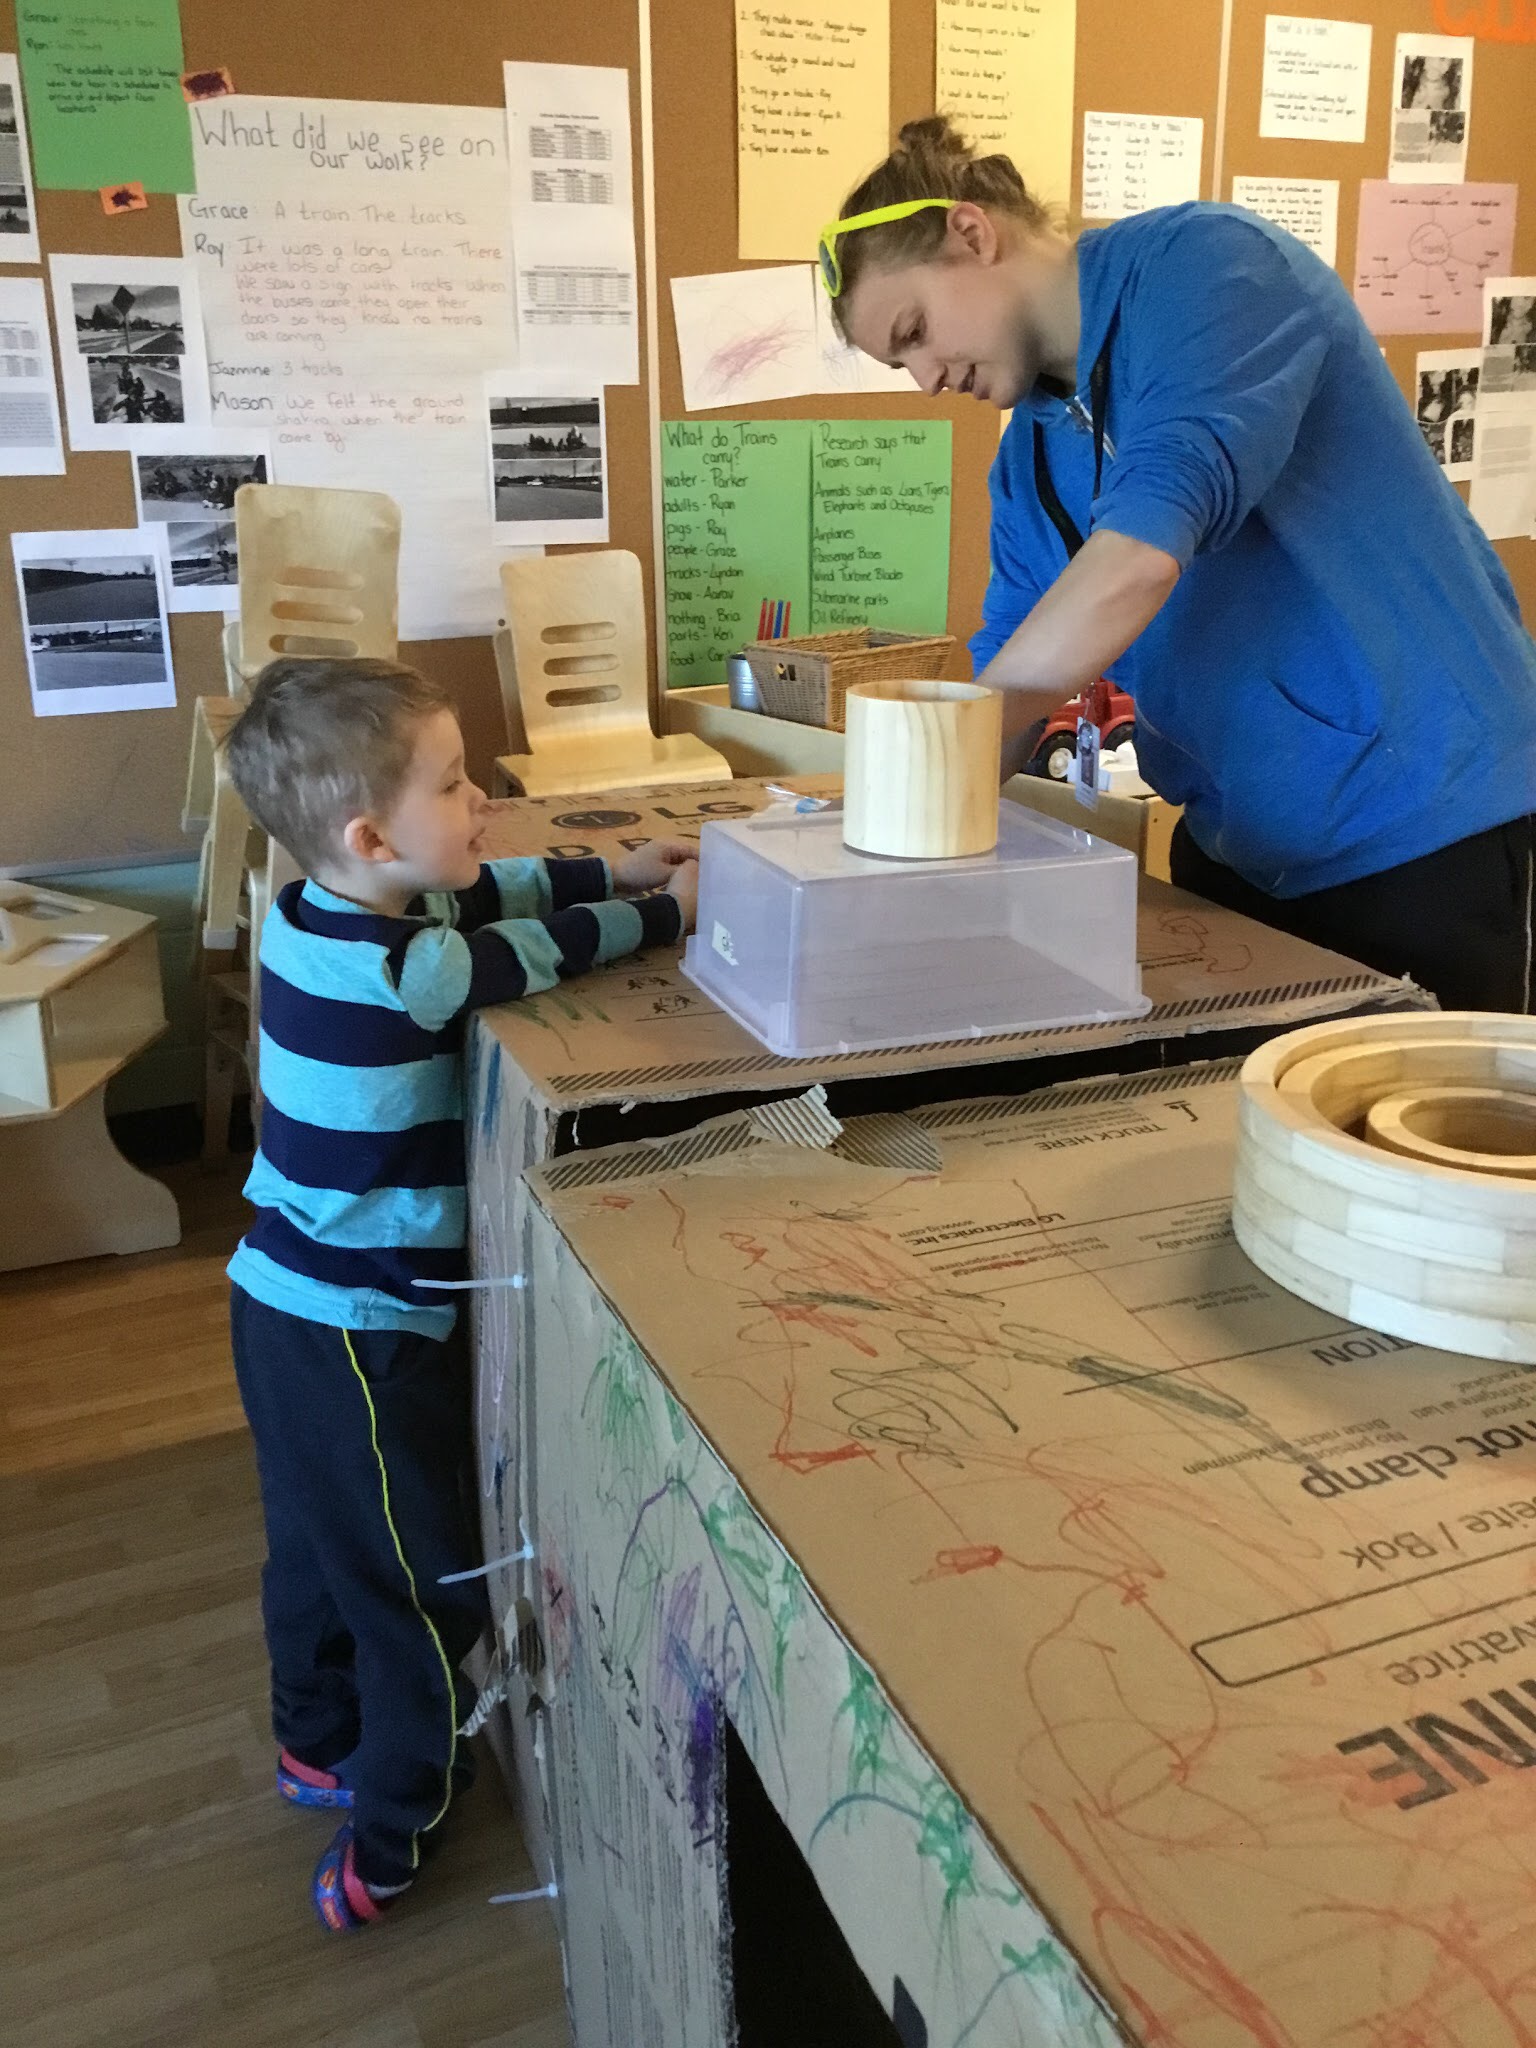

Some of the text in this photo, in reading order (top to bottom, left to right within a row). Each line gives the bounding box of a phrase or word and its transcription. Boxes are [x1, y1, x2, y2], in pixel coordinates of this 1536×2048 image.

[195, 107, 495, 156] What did we see on
[275, 200, 286, 220] A
[359, 204, 396, 223] The
[409, 203, 467, 225] tracks
[238, 236, 267, 255] It
[282, 242, 324, 257] was
[334, 244, 343, 259] a
[354, 240, 392, 262] long
[453, 241, 504, 260] There
[237, 260, 278, 274] were
[287, 259, 318, 274] lots
[327, 259, 343, 274] of
[266, 278, 296, 291] saw
[303, 279, 312, 290] a
[319, 277, 353, 295] sign
[363, 276, 399, 291] with
[410, 276, 454, 292] tracks
[239, 292, 263, 306] the
[273, 296, 314, 308] buses
[358, 294, 390, 311] they
[396, 297, 431, 314] open
[436, 294, 471, 309] their
[240, 311, 484, 333] doors so they know no trains
[245, 330, 268, 342] are
[282, 361, 293, 376] 3
[301, 360, 344, 377] tracks
[211, 391, 275, 412] Mason
[327, 391, 357, 410] felt
[369, 391, 398, 409] the
[412, 393, 466, 418] ground
[275, 412, 468, 428] shaking when the train
[278, 430, 345, 452] came by
[665, 421, 778, 448] What do Trains
[818, 422, 927, 454] Research says that
[702, 446, 741, 472] carry?
[815, 452, 850, 469] Trains
[665, 467, 749, 488] water Parker
[814, 481, 851, 498] Animals
[856, 484, 878, 497] such
[880, 486, 893, 496] as
[664, 493, 736, 516] adults Ryan
[823, 498, 935, 516] Elephants and Octopuses
[666, 519, 728, 544] pigs Ray
[813, 526, 855, 544] Airplanes
[667, 542, 737, 559] people Grace
[812, 545, 882, 562] Passenger Buses
[710, 562, 744, 585] Lyndon
[812, 587, 889, 608] Submarine parts
[668, 609, 706, 630] nothing
[830, 608, 869, 625] Refinery
[669, 628, 700, 645] parts
[669, 651, 695, 666] food
[1034, 1123, 1168, 1151] TRUCK HERE
[938, 1217, 1037, 1242] Electronics
[1036, 1212, 1066, 1225] LG
[1300, 1420, 1536, 1498] not clamp
[1458, 1496, 1536, 1533] eite
[1338, 1531, 1439, 1572] Bok
[1384, 1614, 1536, 1686] vatrice
[1336, 1679, 1536, 1811] INE
